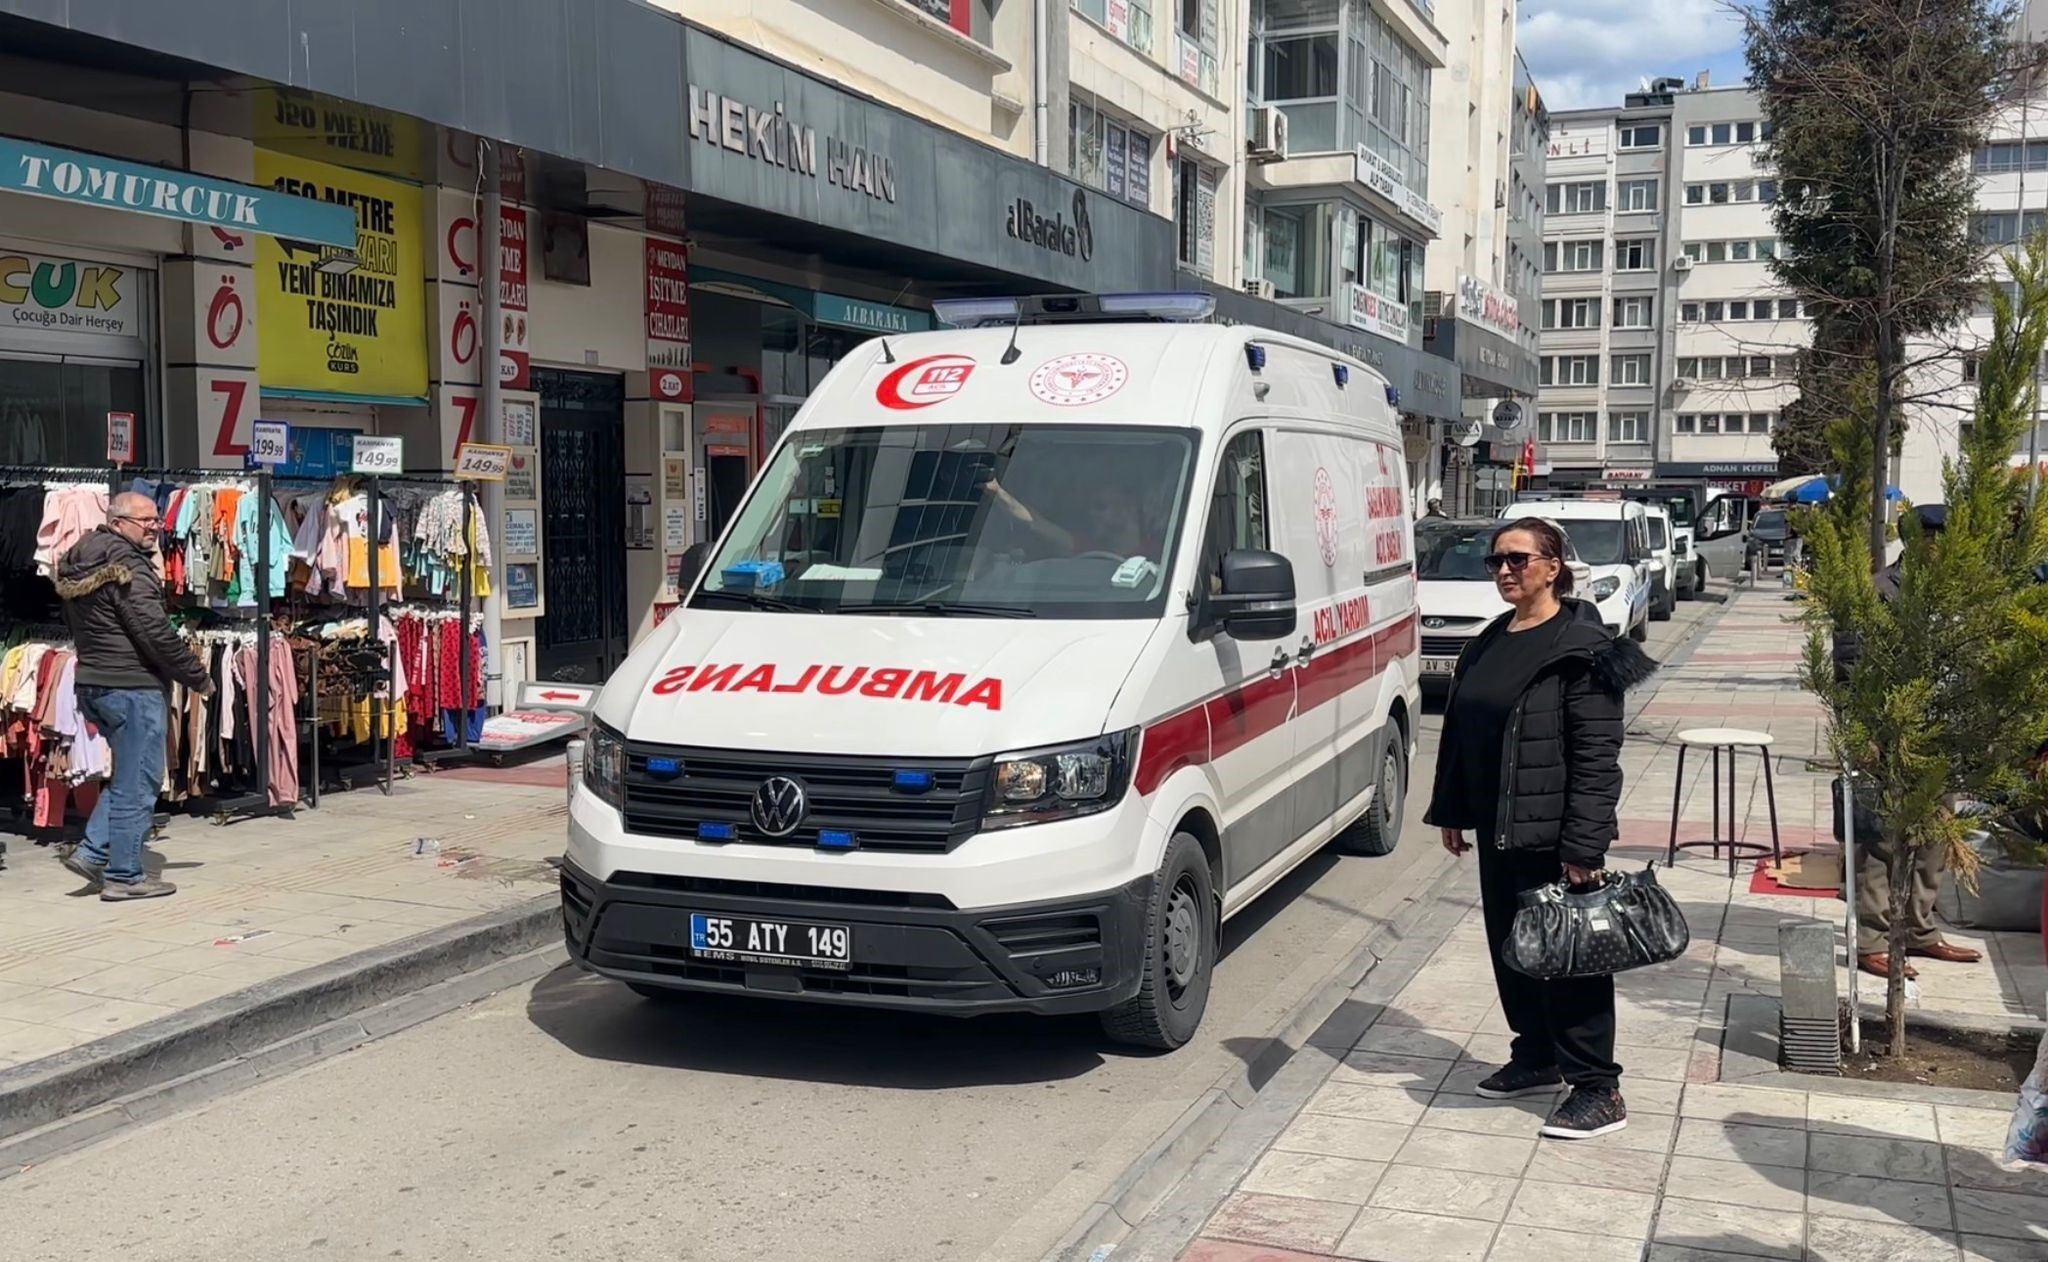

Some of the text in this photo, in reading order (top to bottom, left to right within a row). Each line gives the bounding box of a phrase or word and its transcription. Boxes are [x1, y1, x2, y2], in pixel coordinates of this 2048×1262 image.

[688, 83, 896, 204] HEKİM HAN
[1546, 138, 1590, 156] NLİ
[19, 153, 260, 226] TOMURCUK
[1006, 197, 1077, 258] alBaraka
[657, 251, 687, 272] MEYDAN
[278, 261, 316, 297] YENİ
[649, 270, 687, 309] İŞİTME
[12, 307, 125, 332] Çocuğa Dair Herşey
[306, 299, 379, 341] TAŞINDIK
[649, 308, 690, 340] CİHAZLARI
[843, 305, 908, 332] ALBARAKA
[326, 342, 359, 361] ÇÖZÜM
[330, 361, 357, 372] KURS
[927, 365, 965, 383] 112
[1702, 463, 1778, 473] ADNAN KEFELİ
[1313, 594, 1370, 644] ACİL YARDIM
[695, 933, 705, 943] TR
[706, 918, 847, 958] 55 ATY 149
